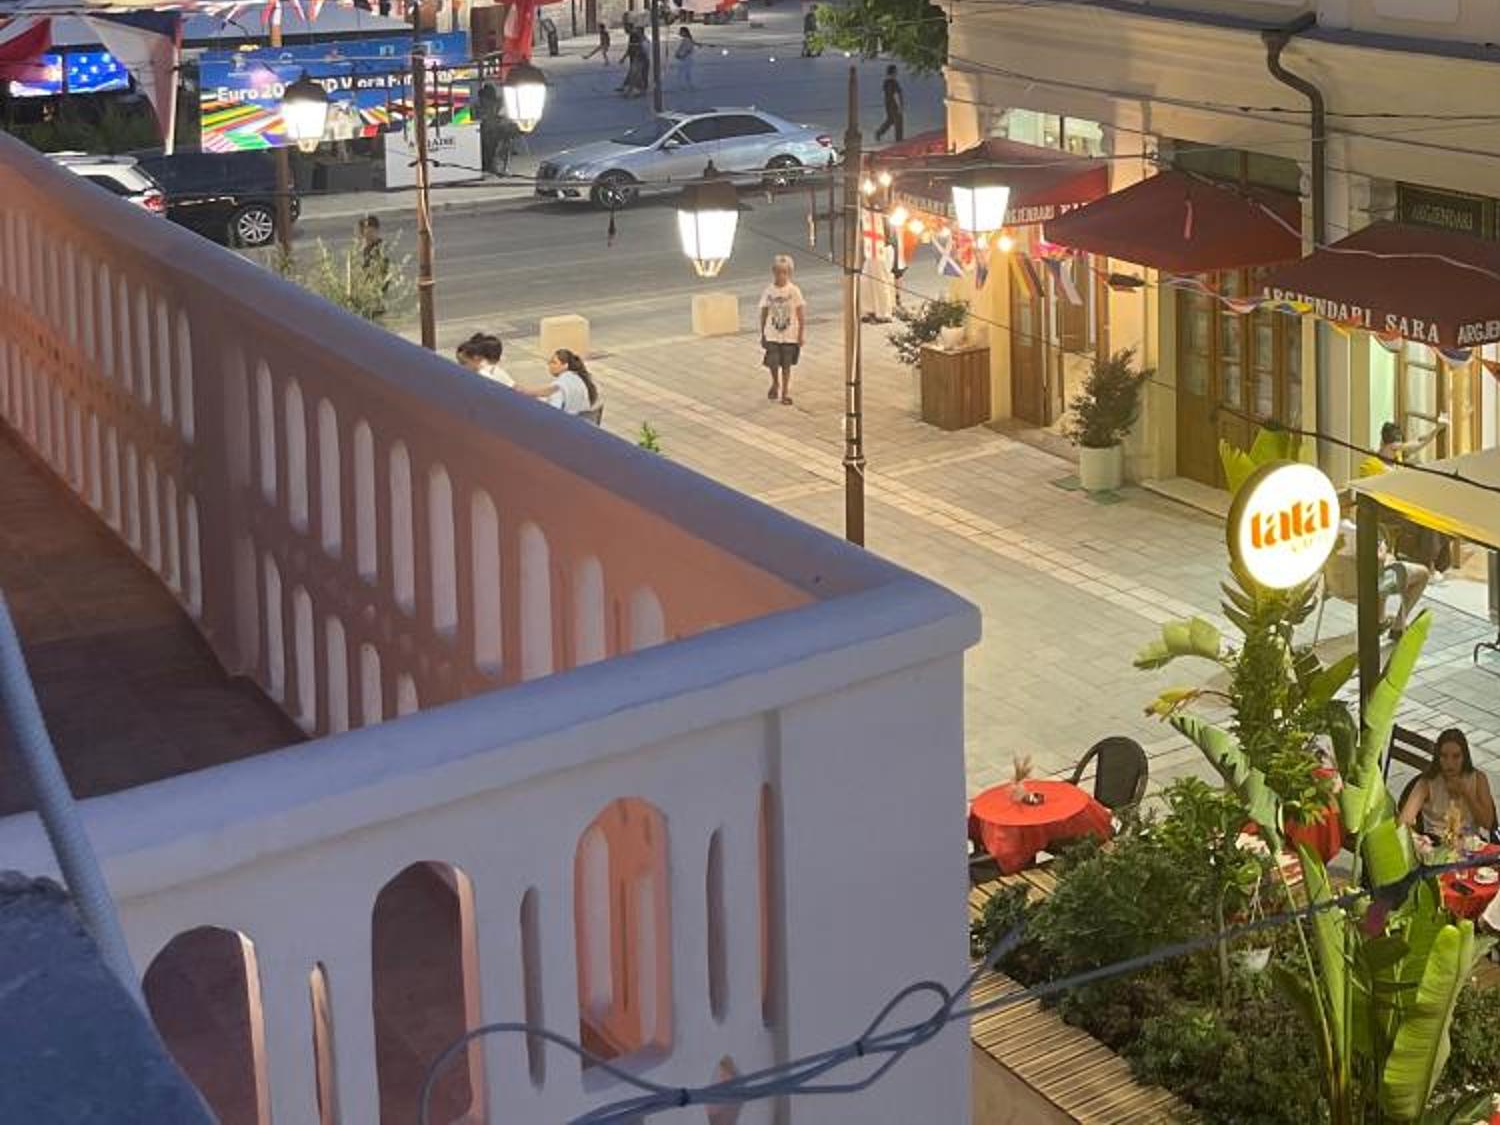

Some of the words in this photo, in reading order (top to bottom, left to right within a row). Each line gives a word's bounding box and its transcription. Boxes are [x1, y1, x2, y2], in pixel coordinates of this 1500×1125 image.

[217, 85, 259, 102] Euro
[1385, 313, 1441, 344] SARA
[1251, 499, 1330, 550] tata
